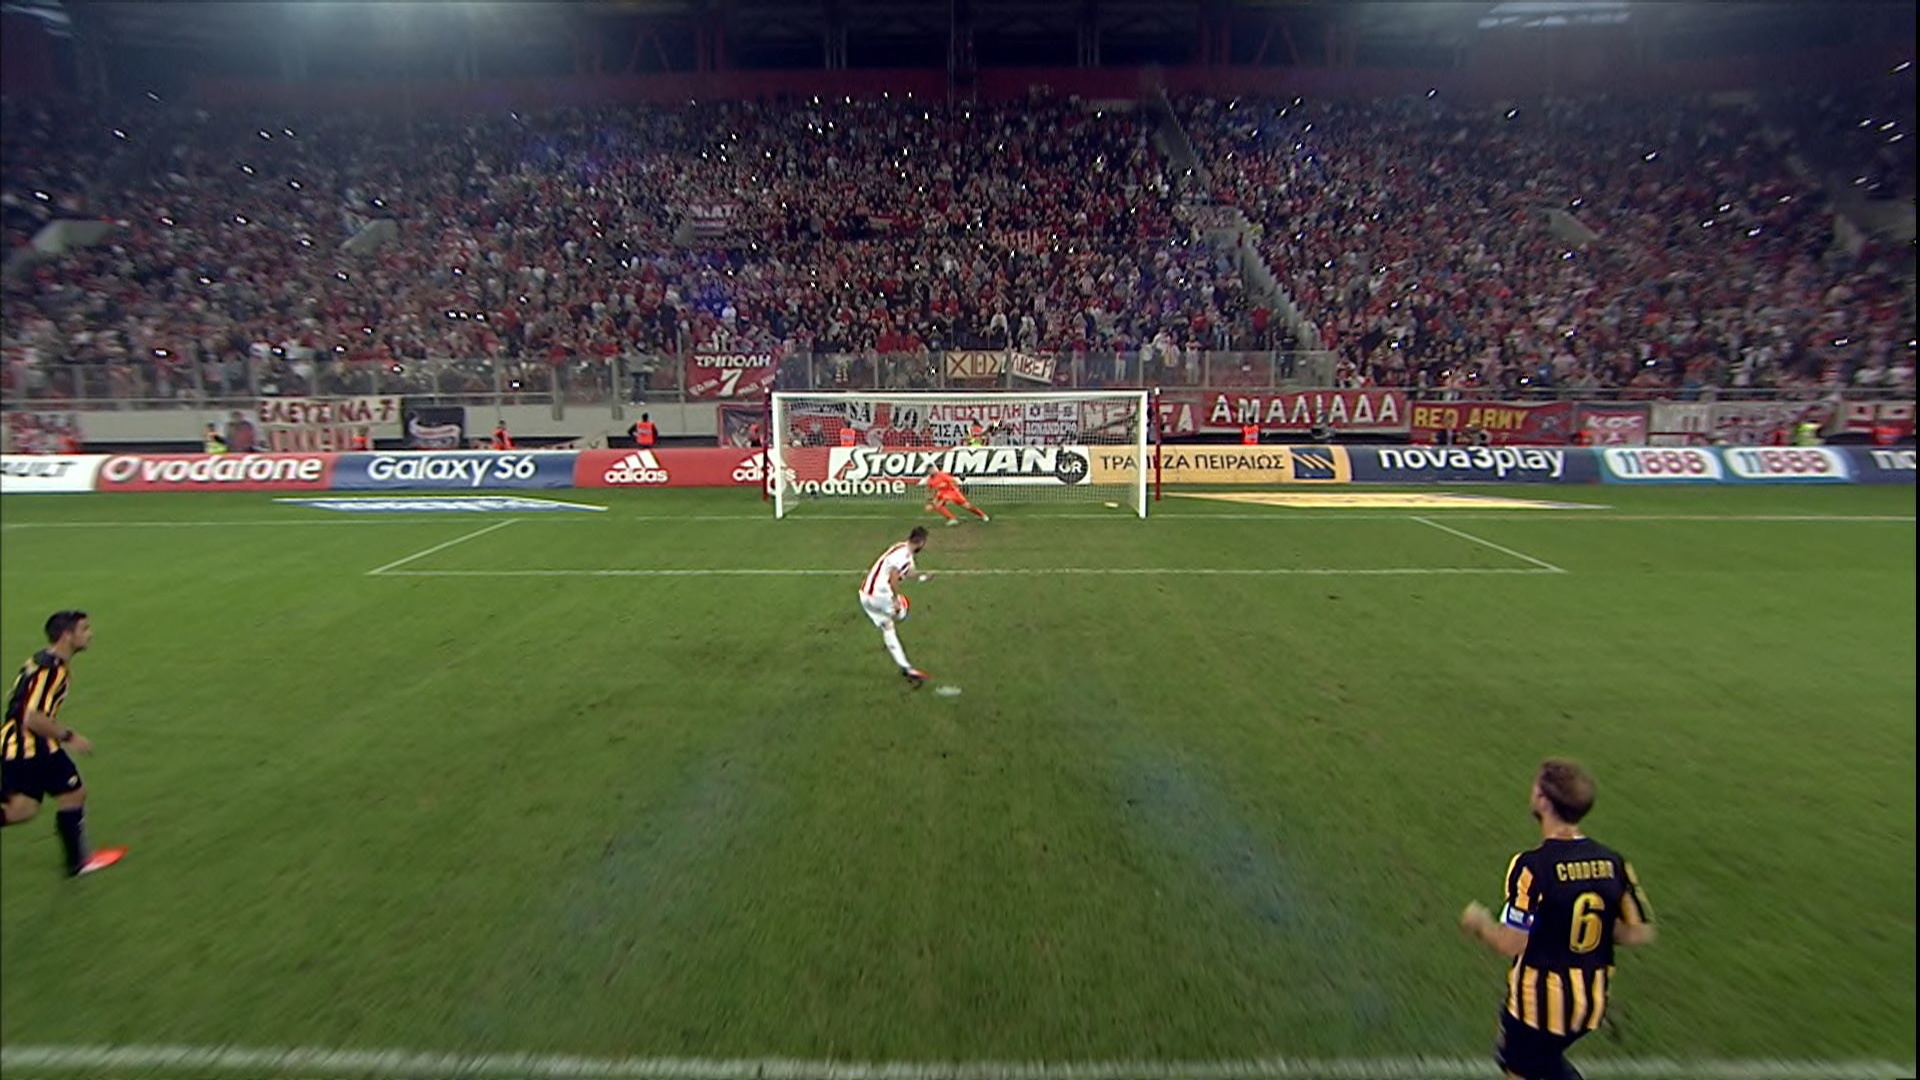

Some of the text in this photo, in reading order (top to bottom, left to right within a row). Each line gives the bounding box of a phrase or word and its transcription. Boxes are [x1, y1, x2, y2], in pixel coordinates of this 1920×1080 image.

[719, 368, 743, 396] 7
[1413, 408, 1459, 428] RED
[141, 454, 323, 482] vodafone
[368, 455, 535, 486] Galaxy S6
[604, 468, 669, 483] adidas
[1378, 447, 1564, 477] nova3play
[1617, 450, 1707, 474] 11888
[1737, 450, 1828, 474] 11888
[1569, 891, 1605, 954] 6
